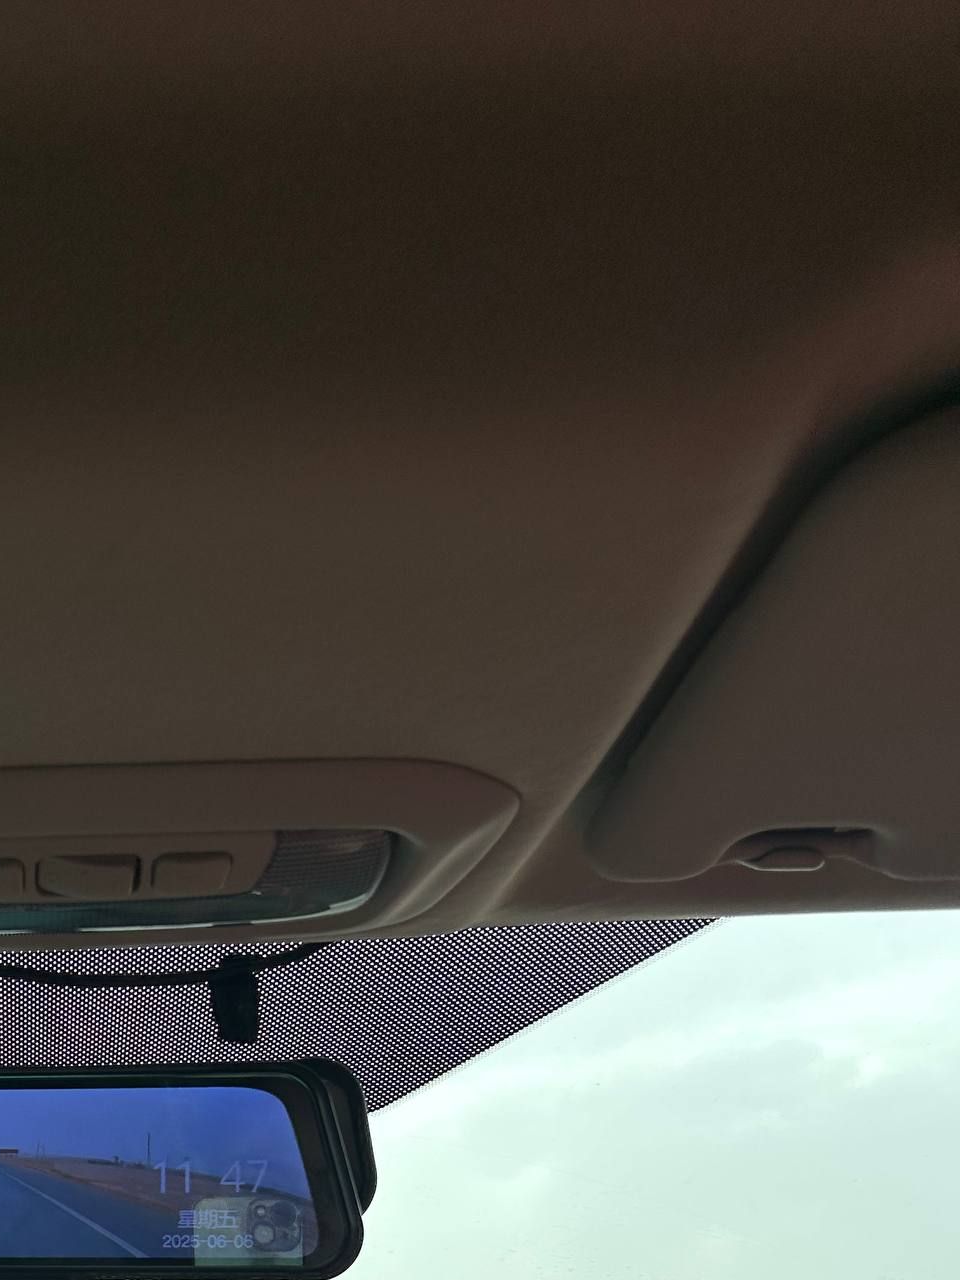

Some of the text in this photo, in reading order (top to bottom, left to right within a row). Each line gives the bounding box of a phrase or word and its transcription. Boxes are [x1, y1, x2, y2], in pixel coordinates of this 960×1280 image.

[153, 1160, 268, 1194] 11 47
[177, 1209, 239, 1230] 星期五
[162, 1234, 254, 1249] 2025-06-06
